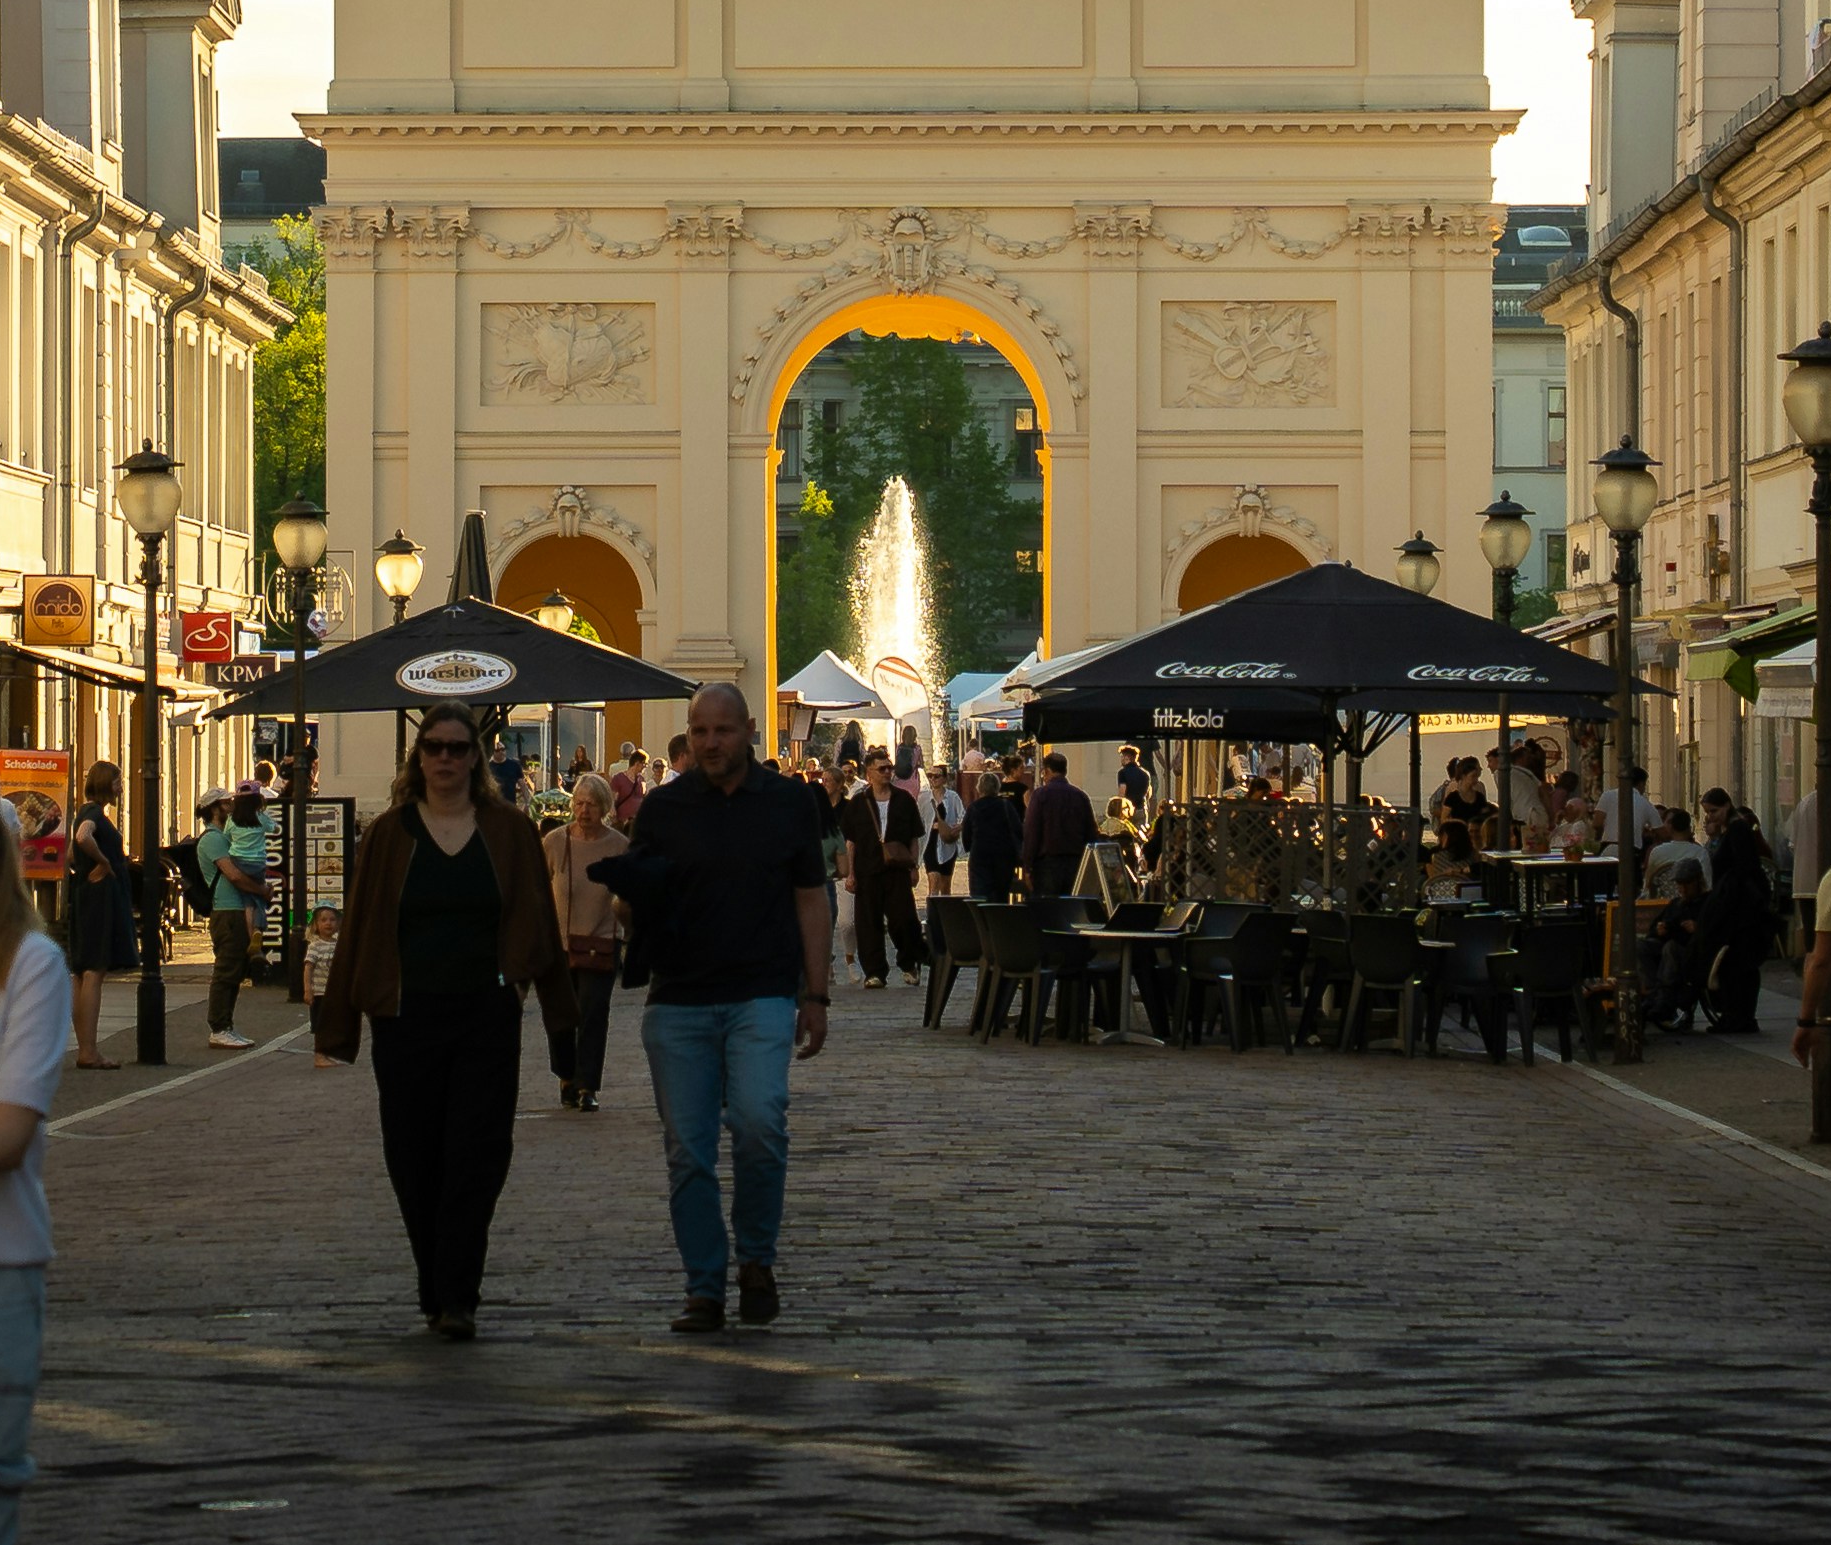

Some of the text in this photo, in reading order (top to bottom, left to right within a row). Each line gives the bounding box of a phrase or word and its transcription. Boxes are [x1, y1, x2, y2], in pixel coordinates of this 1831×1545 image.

[35, 591, 83, 615] mido
[216, 665, 264, 682] KPM
[408, 665, 506, 681] Warsteiner
[1155, 661, 1289, 680] Coca-Cola
[1407, 663, 1537, 683] Coca-Cola
[1153, 708, 1225, 729] fritz-kola
[4, 758, 59, 771] Schokolade
